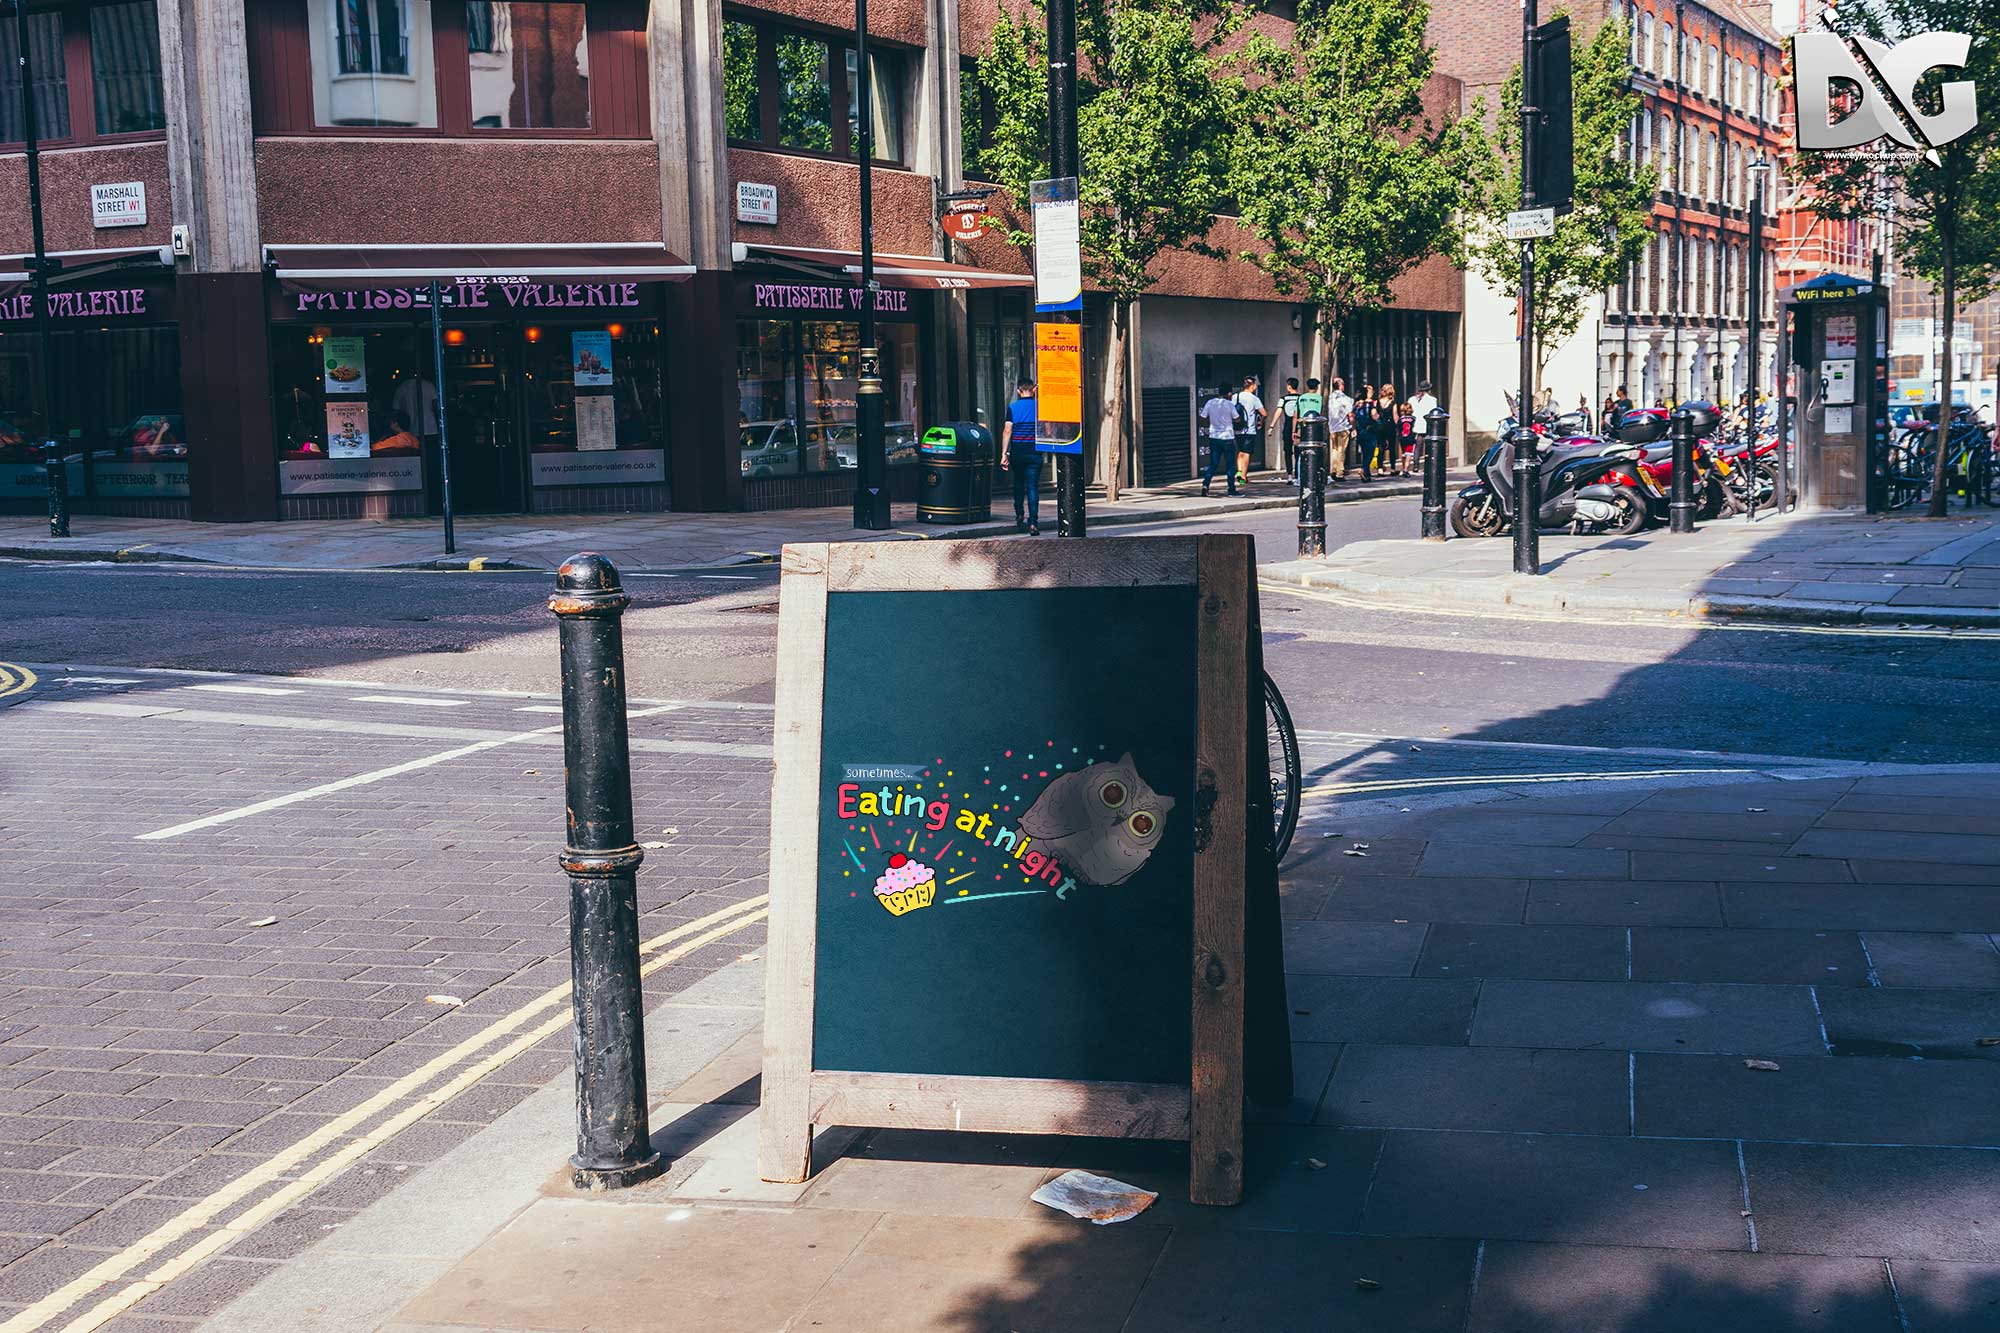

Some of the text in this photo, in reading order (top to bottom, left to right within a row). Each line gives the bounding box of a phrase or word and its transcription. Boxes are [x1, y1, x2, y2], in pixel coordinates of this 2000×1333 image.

[96, 186, 139, 200] MARSHALL
[740, 185, 775, 199] BROADWICK
[97, 200, 141, 213] STREET W1
[741, 198, 771, 211] STREET W1
[1054, 199, 1076, 208] NOTICE
[492, 275, 530, 284] 1926
[500, 281, 640, 308] VALERIE
[754, 283, 844, 311] PATISSERIE
[848, 287, 908, 312] VAERIE
[1796, 289, 1844, 301] WiFi here
[47, 288, 147, 318] VALERIE
[1035, 344, 1079, 353] PUBLIC NOTICE
[540, 461, 656, 473] www.patisserie-valerie.co.uk
[289, 469, 413, 481] www.patisserie-valerie.co.uk
[846, 767, 914, 779] sometimes...
[838, 783, 1077, 901] Eating at night
